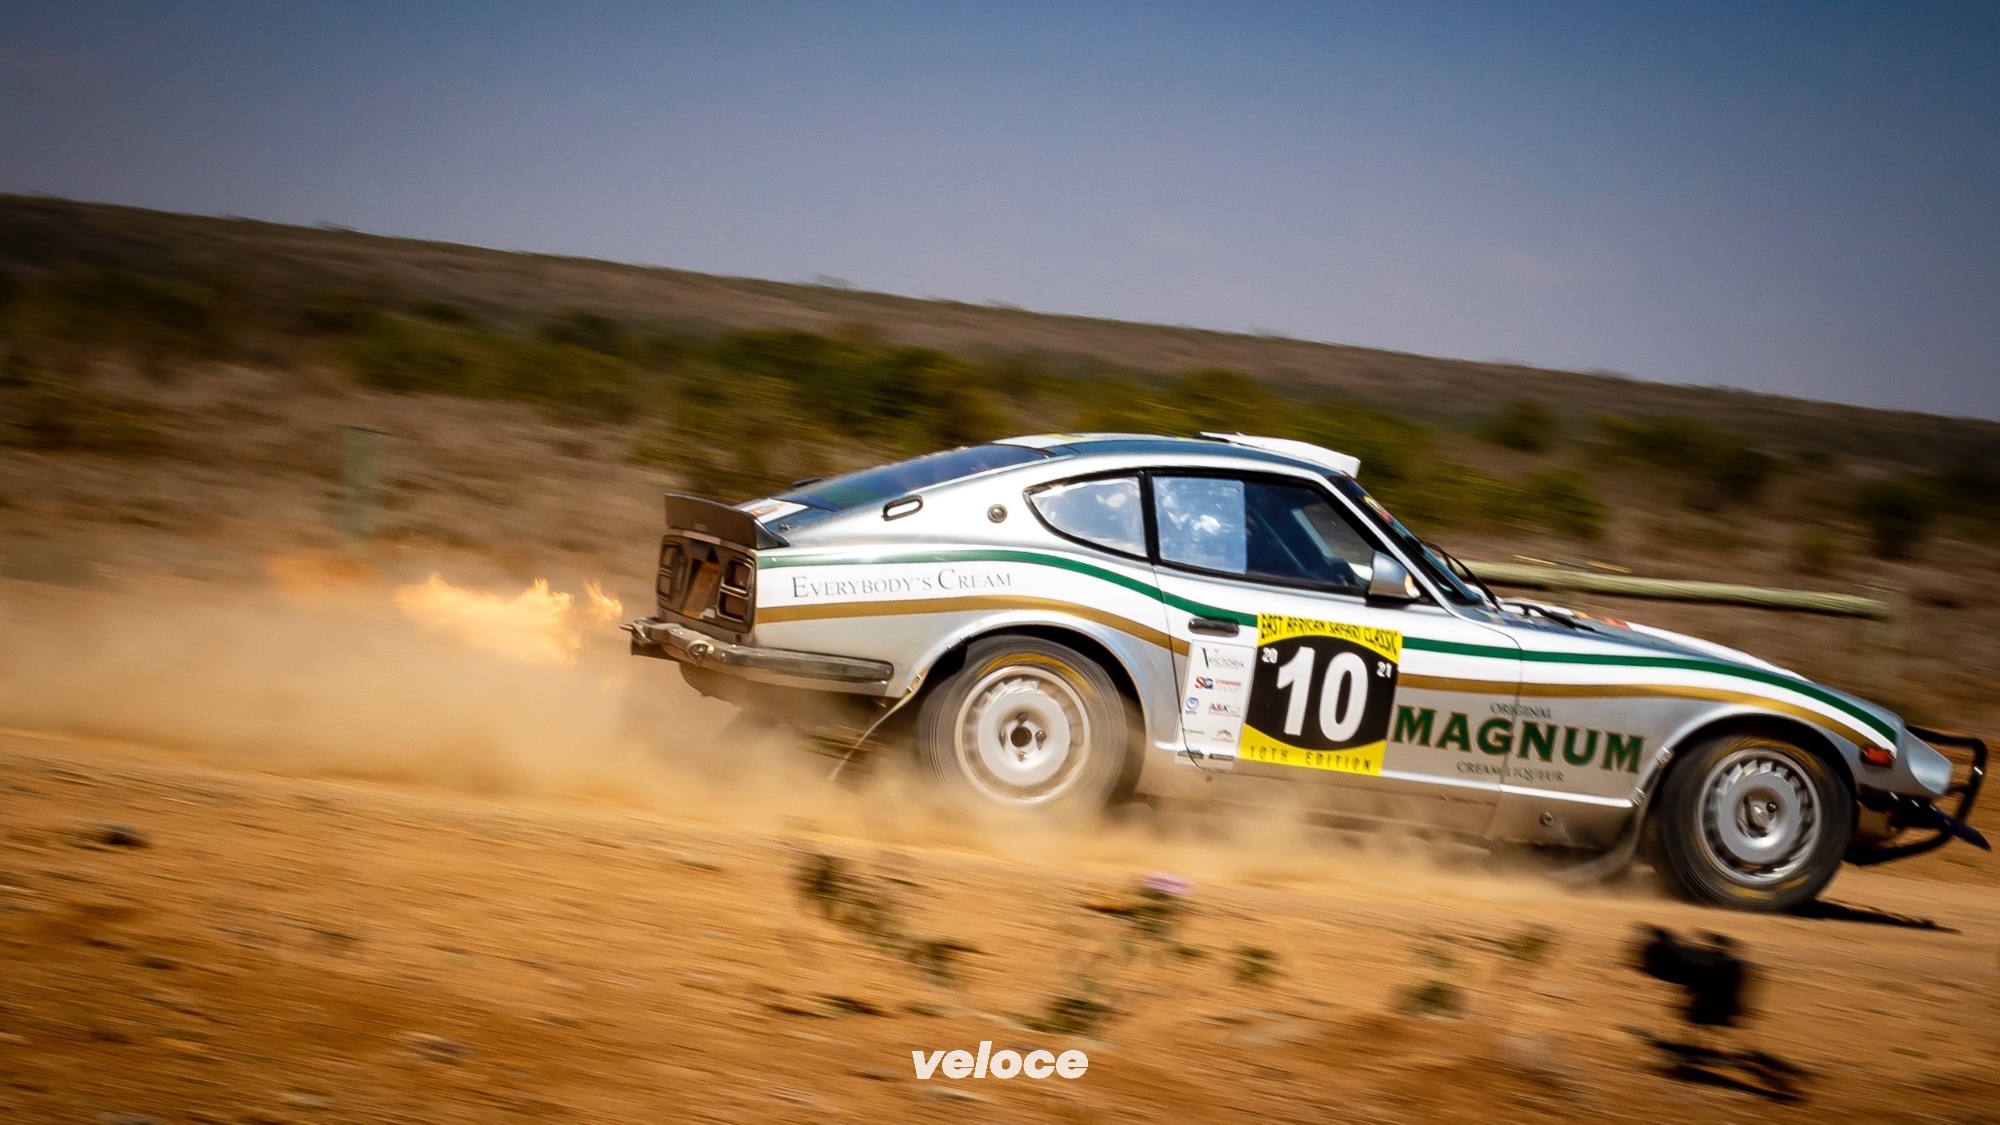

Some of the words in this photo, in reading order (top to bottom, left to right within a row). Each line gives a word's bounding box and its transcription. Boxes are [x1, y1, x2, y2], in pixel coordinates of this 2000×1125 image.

[792, 576, 931, 597] EVERYBODY'S
[938, 568, 1012, 589] CREAM
[1262, 647, 1278, 663] 20
[1376, 661, 1392, 678] 21
[1277, 646, 1368, 742] 10
[1491, 703, 1552, 719] ORIGINAL
[1391, 705, 1646, 773] MAGNUM
[1250, 747, 1288, 762] 10TH
[1305, 752, 1371, 772] EDITION
